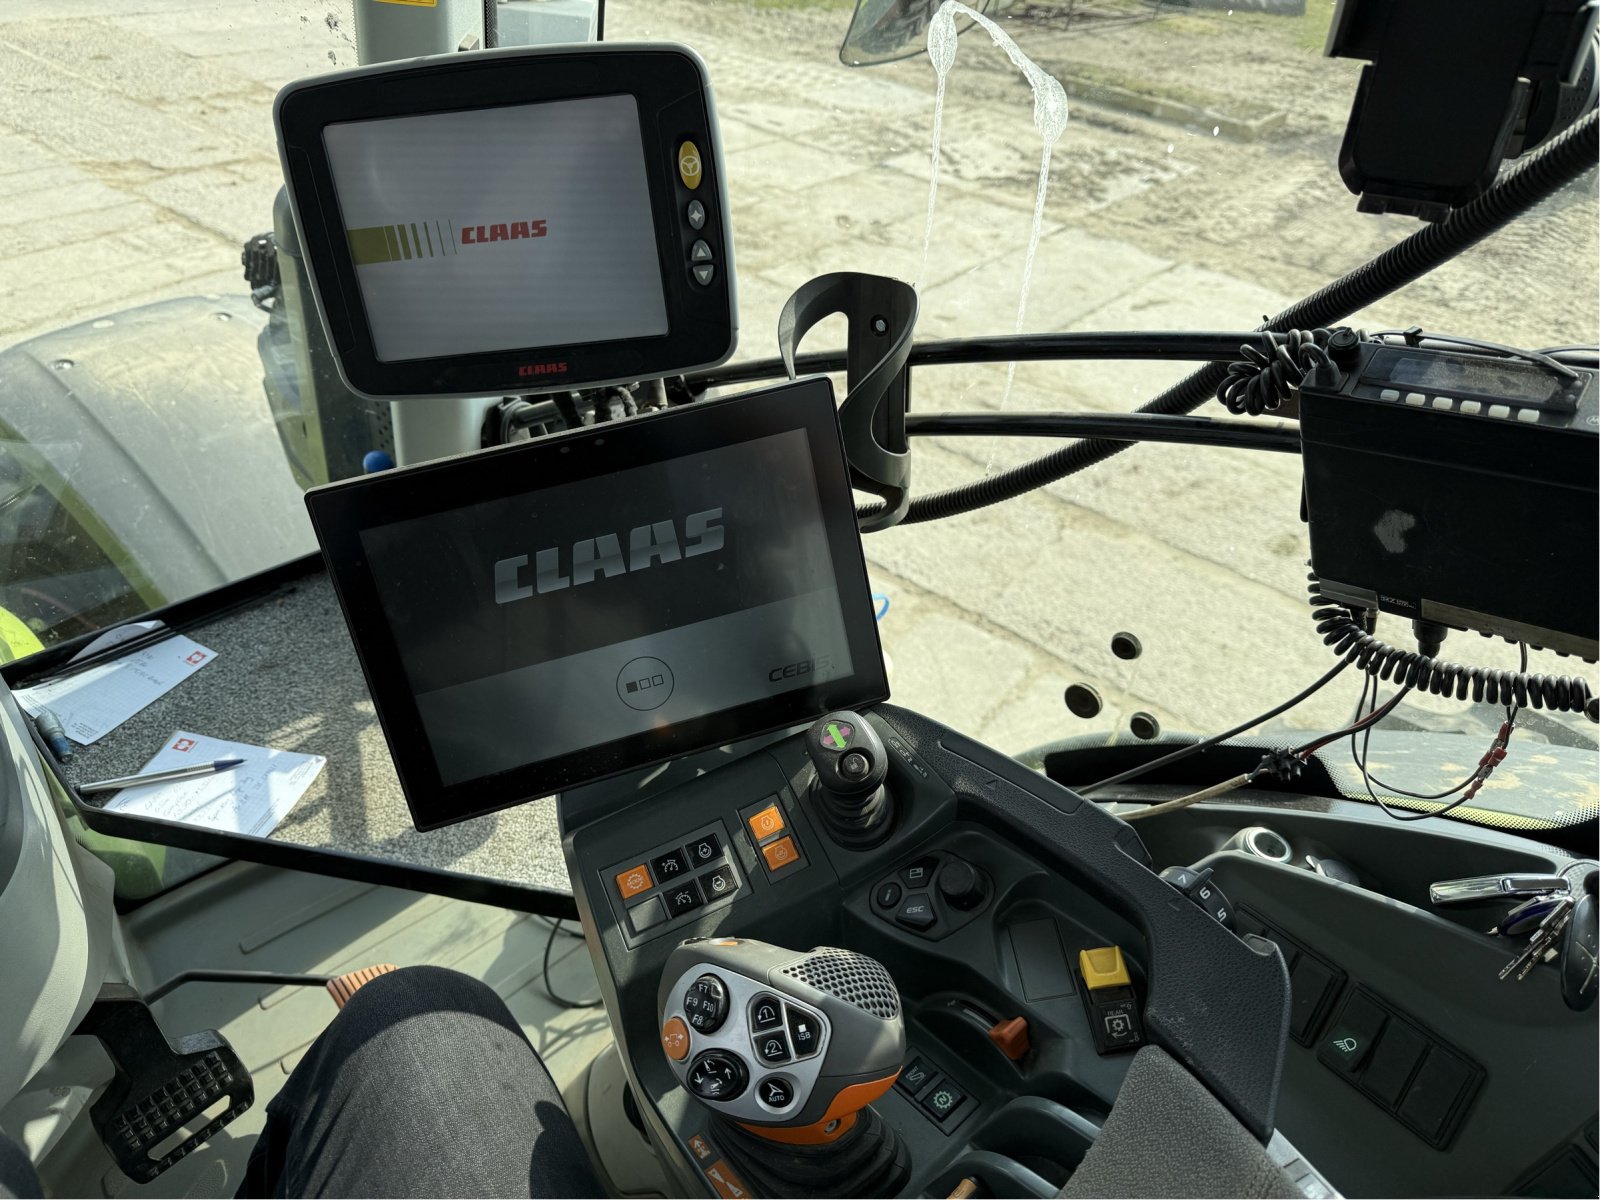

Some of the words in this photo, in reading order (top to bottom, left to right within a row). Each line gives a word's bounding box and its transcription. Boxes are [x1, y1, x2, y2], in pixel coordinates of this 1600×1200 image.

[461, 219, 548, 245] CLAAS
[518, 361, 568, 376] CLAAS
[494, 507, 725, 604] CLAAS
[768, 654, 830, 682] CEBIS
[1177, 873, 1187, 885] 7
[1199, 886, 1211, 900] 6
[906, 905, 925, 914] ESC
[1217, 907, 1227, 923] 5
[698, 983, 708, 994] F7
[686, 996, 699, 1007] F9
[702, 1000, 714, 1013] F10
[691, 1013, 704, 1026] F8
[762, 1008, 769, 1019] 1
[797, 1031, 811, 1041] ISB
[769, 1042, 778, 1053] 2
[768, 1094, 785, 1103] AUTO
